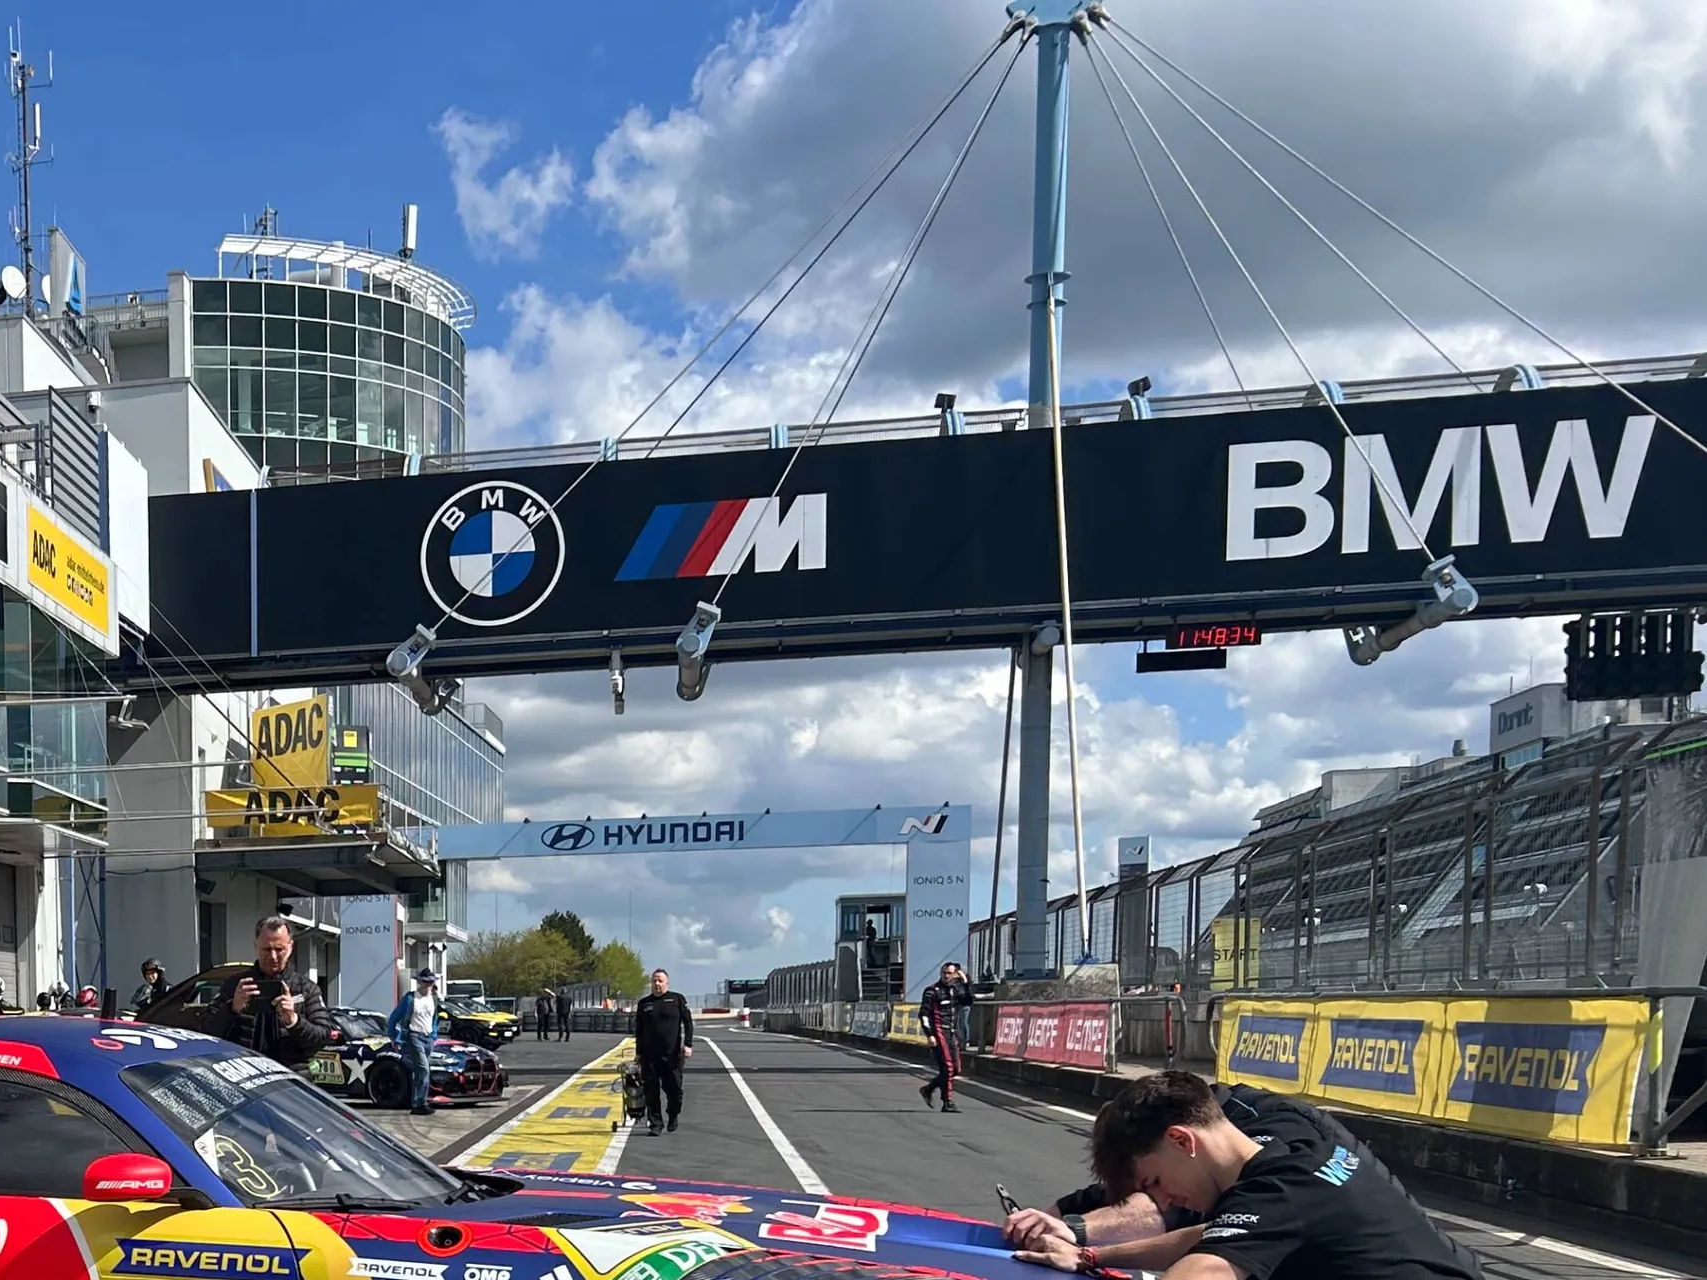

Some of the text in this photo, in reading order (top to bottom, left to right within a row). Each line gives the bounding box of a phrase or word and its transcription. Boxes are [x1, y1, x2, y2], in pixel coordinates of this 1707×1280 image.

[1225, 415, 1657, 562] BMW
[441, 488, 545, 532] BMW
[33, 529, 56, 579] ADAC
[1178, 626, 1257, 648] 11:48:34
[256, 703, 323, 760] ADAC
[244, 788, 340, 825] ADAC
[604, 820, 745, 847] HYUNDAI
[913, 875, 964, 886] IONIQ 5 N
[913, 908, 964, 919] IONIQ 6 N
[345, 925, 390, 935] IONIQ 6 N
[1236, 1031, 1297, 1064] RAVENOL
[1331, 1038, 1410, 1075] RAVENOL
[1463, 1044, 1579, 1091] RAVENOL
[213, 1134, 279, 1198] 3
[119, 1180, 164, 1189] AMG
[1215, 1213, 1260, 1224] DDOCK
[130, 1247, 290, 1275] RAVENOL
[356, 1262, 438, 1278] RAVENOL
